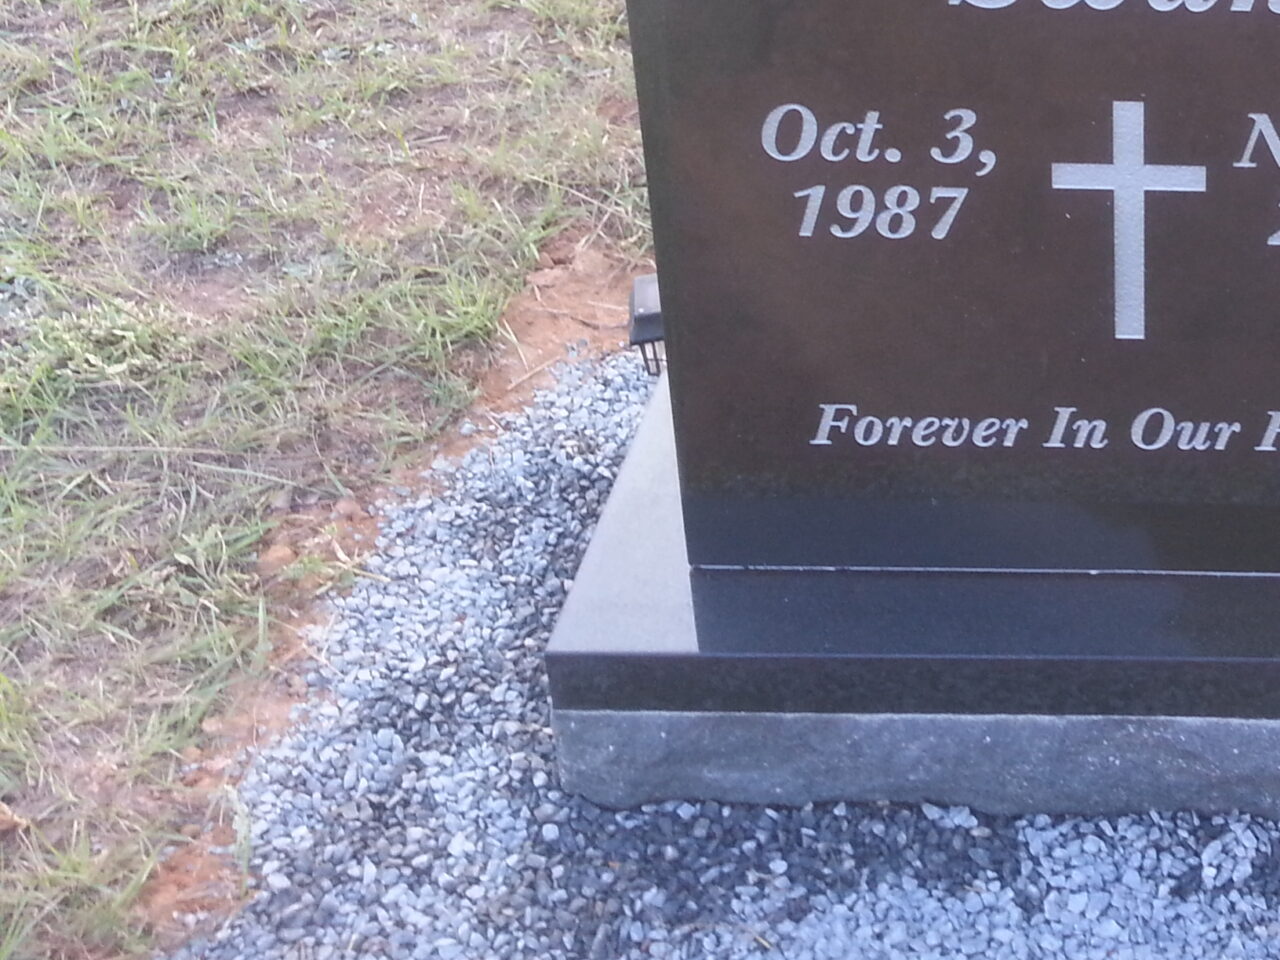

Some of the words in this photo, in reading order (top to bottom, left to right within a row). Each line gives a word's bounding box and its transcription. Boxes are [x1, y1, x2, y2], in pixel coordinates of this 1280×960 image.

[760, 102, 903, 163] Oct.
[928, 107, 998, 178] 3,
[792, 183, 970, 240] 1987
[808, 402, 1030, 449] Forever
[1041, 405, 1109, 450] In
[1129, 406, 1242, 452] Our
